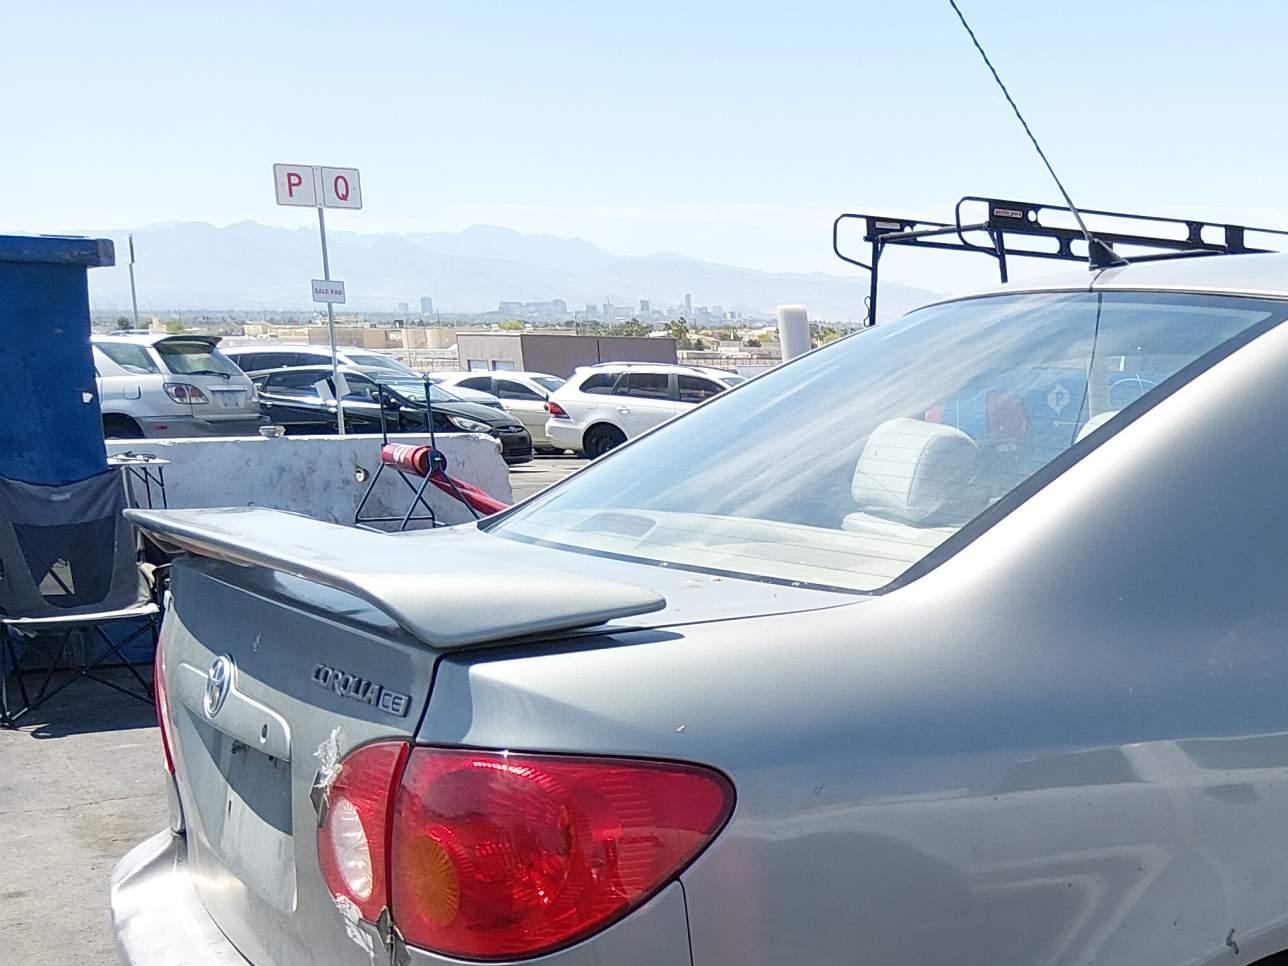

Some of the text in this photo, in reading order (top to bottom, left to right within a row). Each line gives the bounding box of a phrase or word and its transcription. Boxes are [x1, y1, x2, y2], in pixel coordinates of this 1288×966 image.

[287, 172, 302, 198] P
[333, 175, 349, 201] Q
[312, 664, 383, 706] COROLLA
